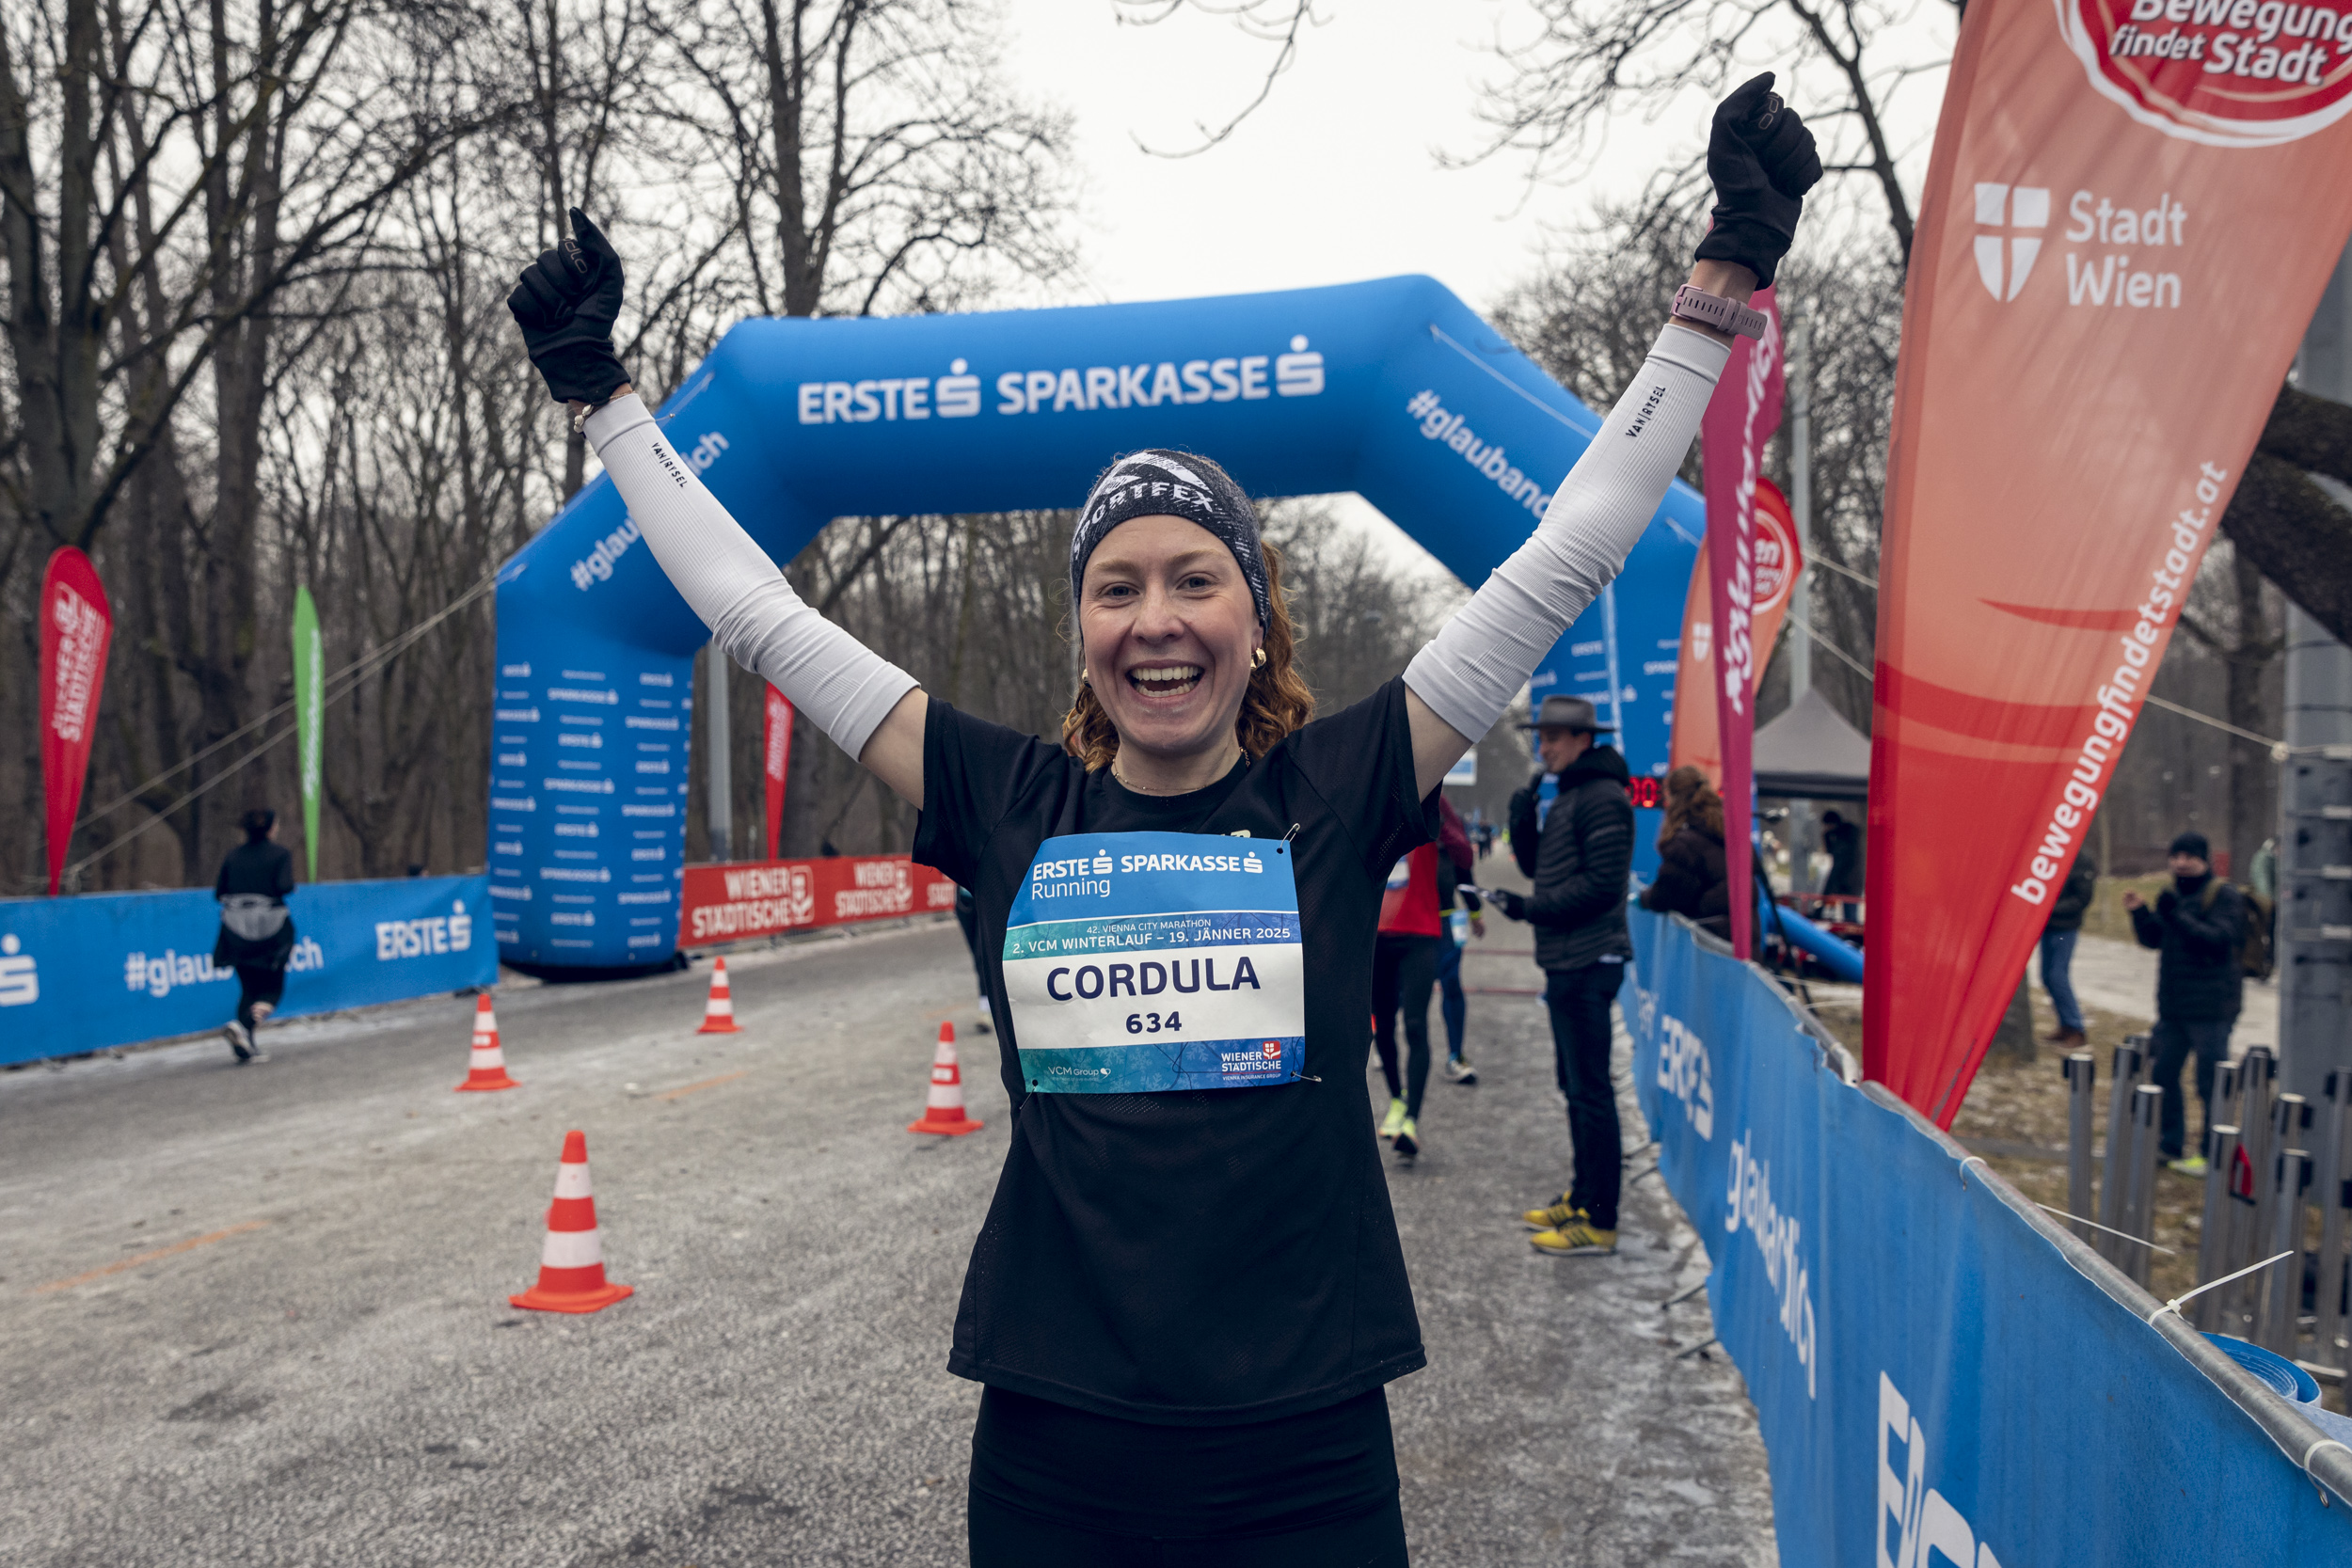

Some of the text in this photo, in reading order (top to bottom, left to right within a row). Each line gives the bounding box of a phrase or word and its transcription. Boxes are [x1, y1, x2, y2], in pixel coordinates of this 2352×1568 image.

[2109, 24, 2328, 87] findet Stadt
[2066, 190, 2187, 246] Stadt
[2066, 252, 2182, 309] Wien
[798, 355, 1270, 424] ERSTE SPARKASSE
[2010, 460, 2228, 906] bewegungfindetstadt.at
[1033, 854, 1241, 881] ERSTE SPARKASSE
[723, 866, 791, 901] WIENER
[1032, 877, 1111, 900] Running
[374, 915, 449, 961] ERSTE
[1012, 942, 1025, 955] 2.
[1028, 939, 1057, 953] VCM
[1061, 932, 1153, 950] WINTERLAUF
[1169, 931, 1189, 943] 19.
[1194, 927, 1252, 942] JÄNNER
[1256, 927, 1291, 939] 2025
[1087, 918, 1212, 934] 42. VIENNA CITY MARATHON
[1046, 956, 1262, 1002] CORDULA
[1125, 1011, 1183, 1035] 634
[1047, 1066, 1100, 1077] VCM Group
[1221, 1051, 1263, 1063] WIENER
[1221, 1060, 1282, 1073] STÄDTISCHE
